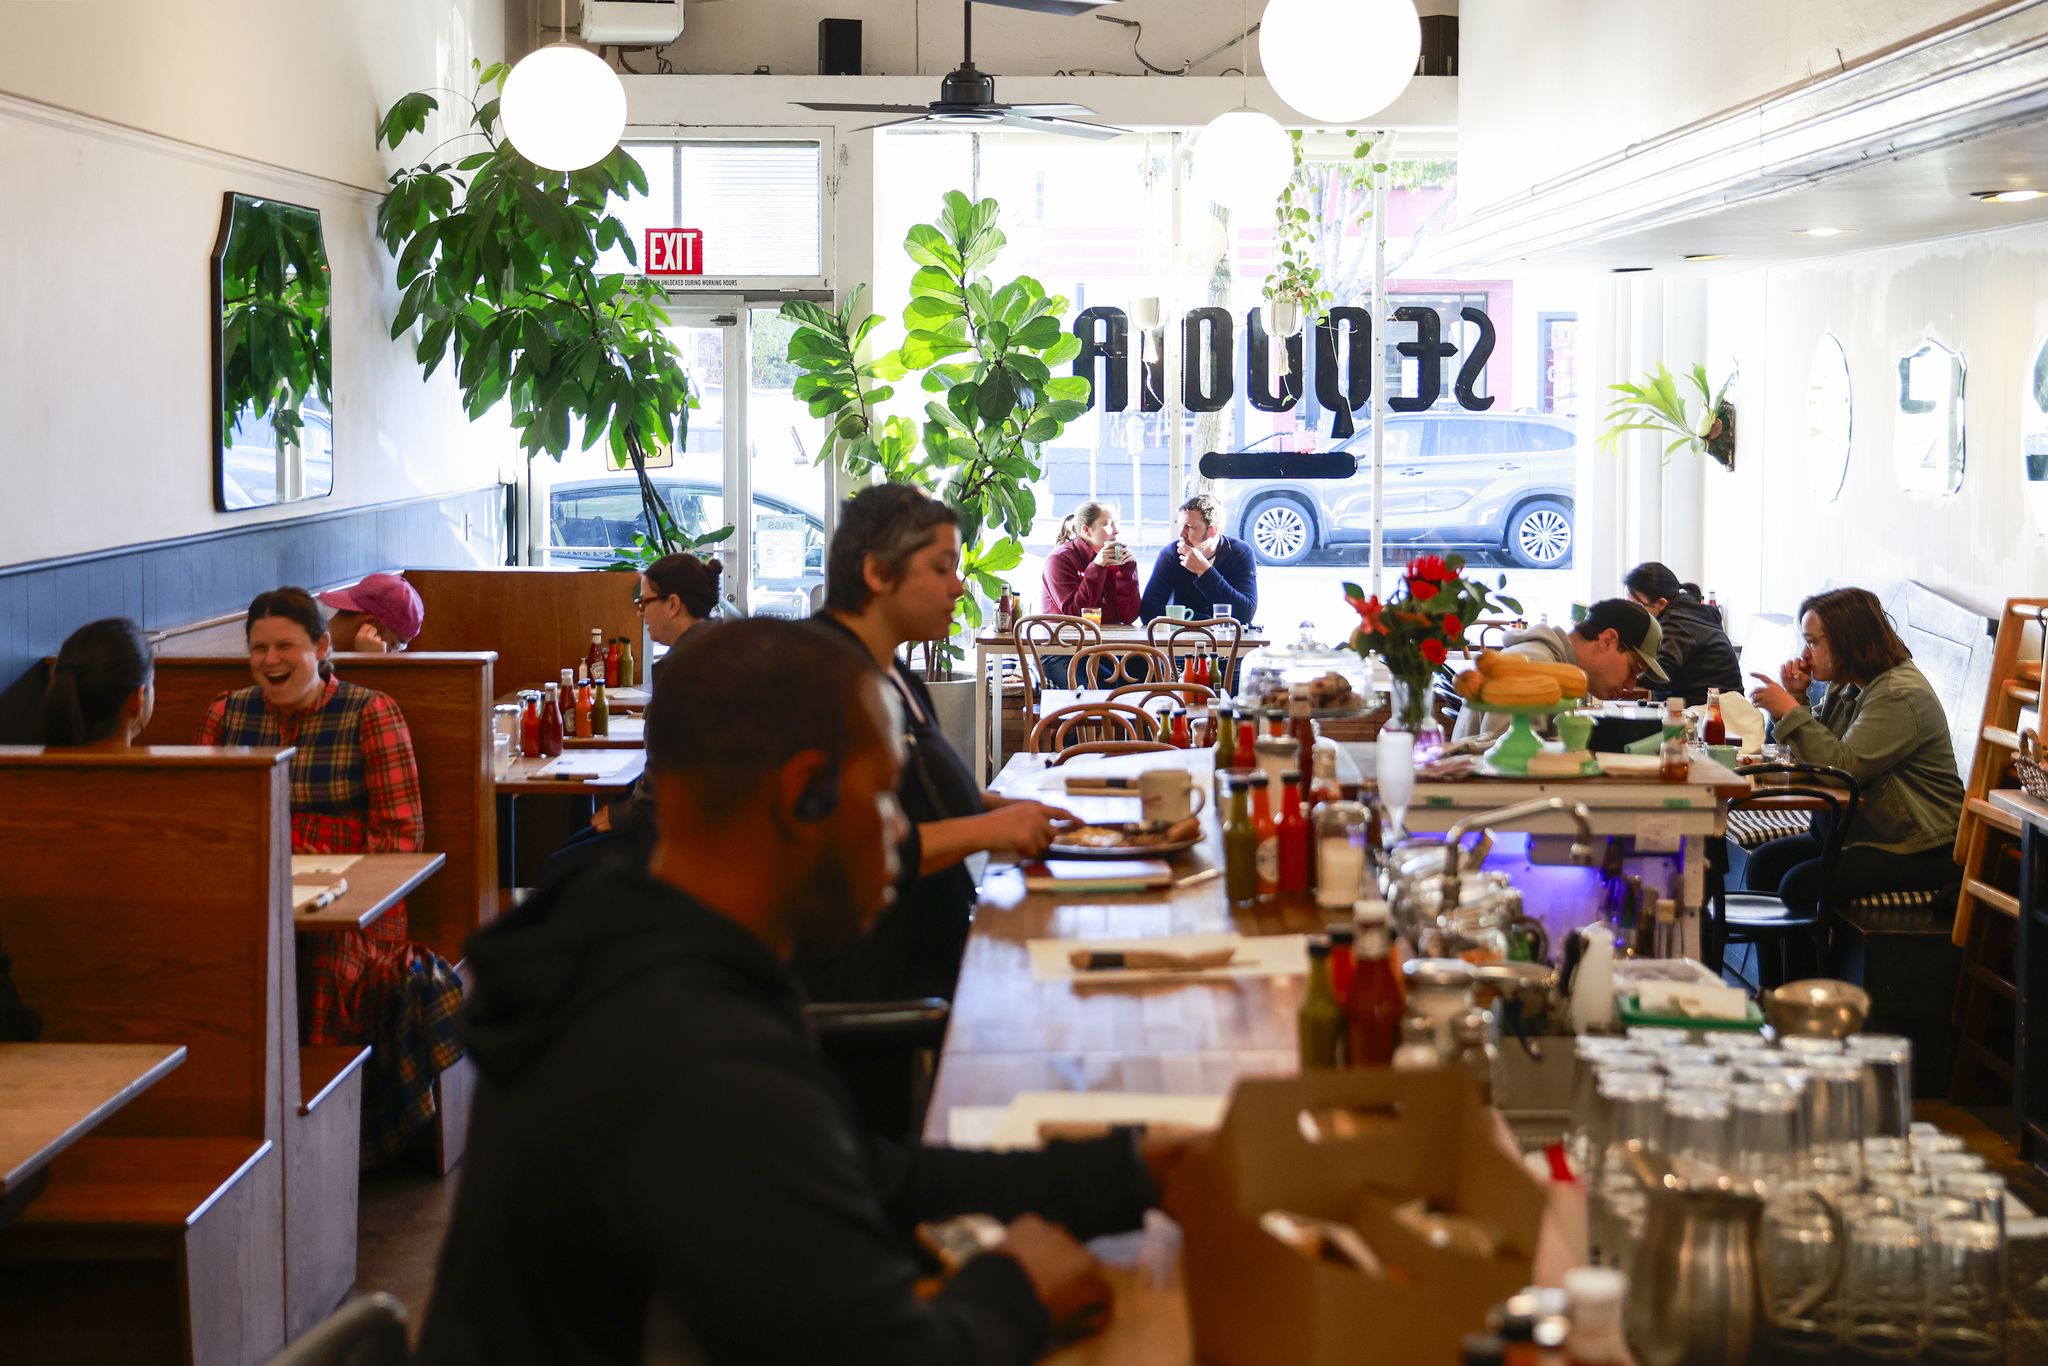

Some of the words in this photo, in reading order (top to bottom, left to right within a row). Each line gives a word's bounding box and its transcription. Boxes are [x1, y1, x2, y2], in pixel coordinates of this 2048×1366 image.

[649, 232, 698, 271] EXIT
[661, 279, 684, 287] UNLOCKED
[684, 279, 701, 287] DURING
[702, 279, 722, 287] WORKING
[723, 279, 738, 287] HOURS
